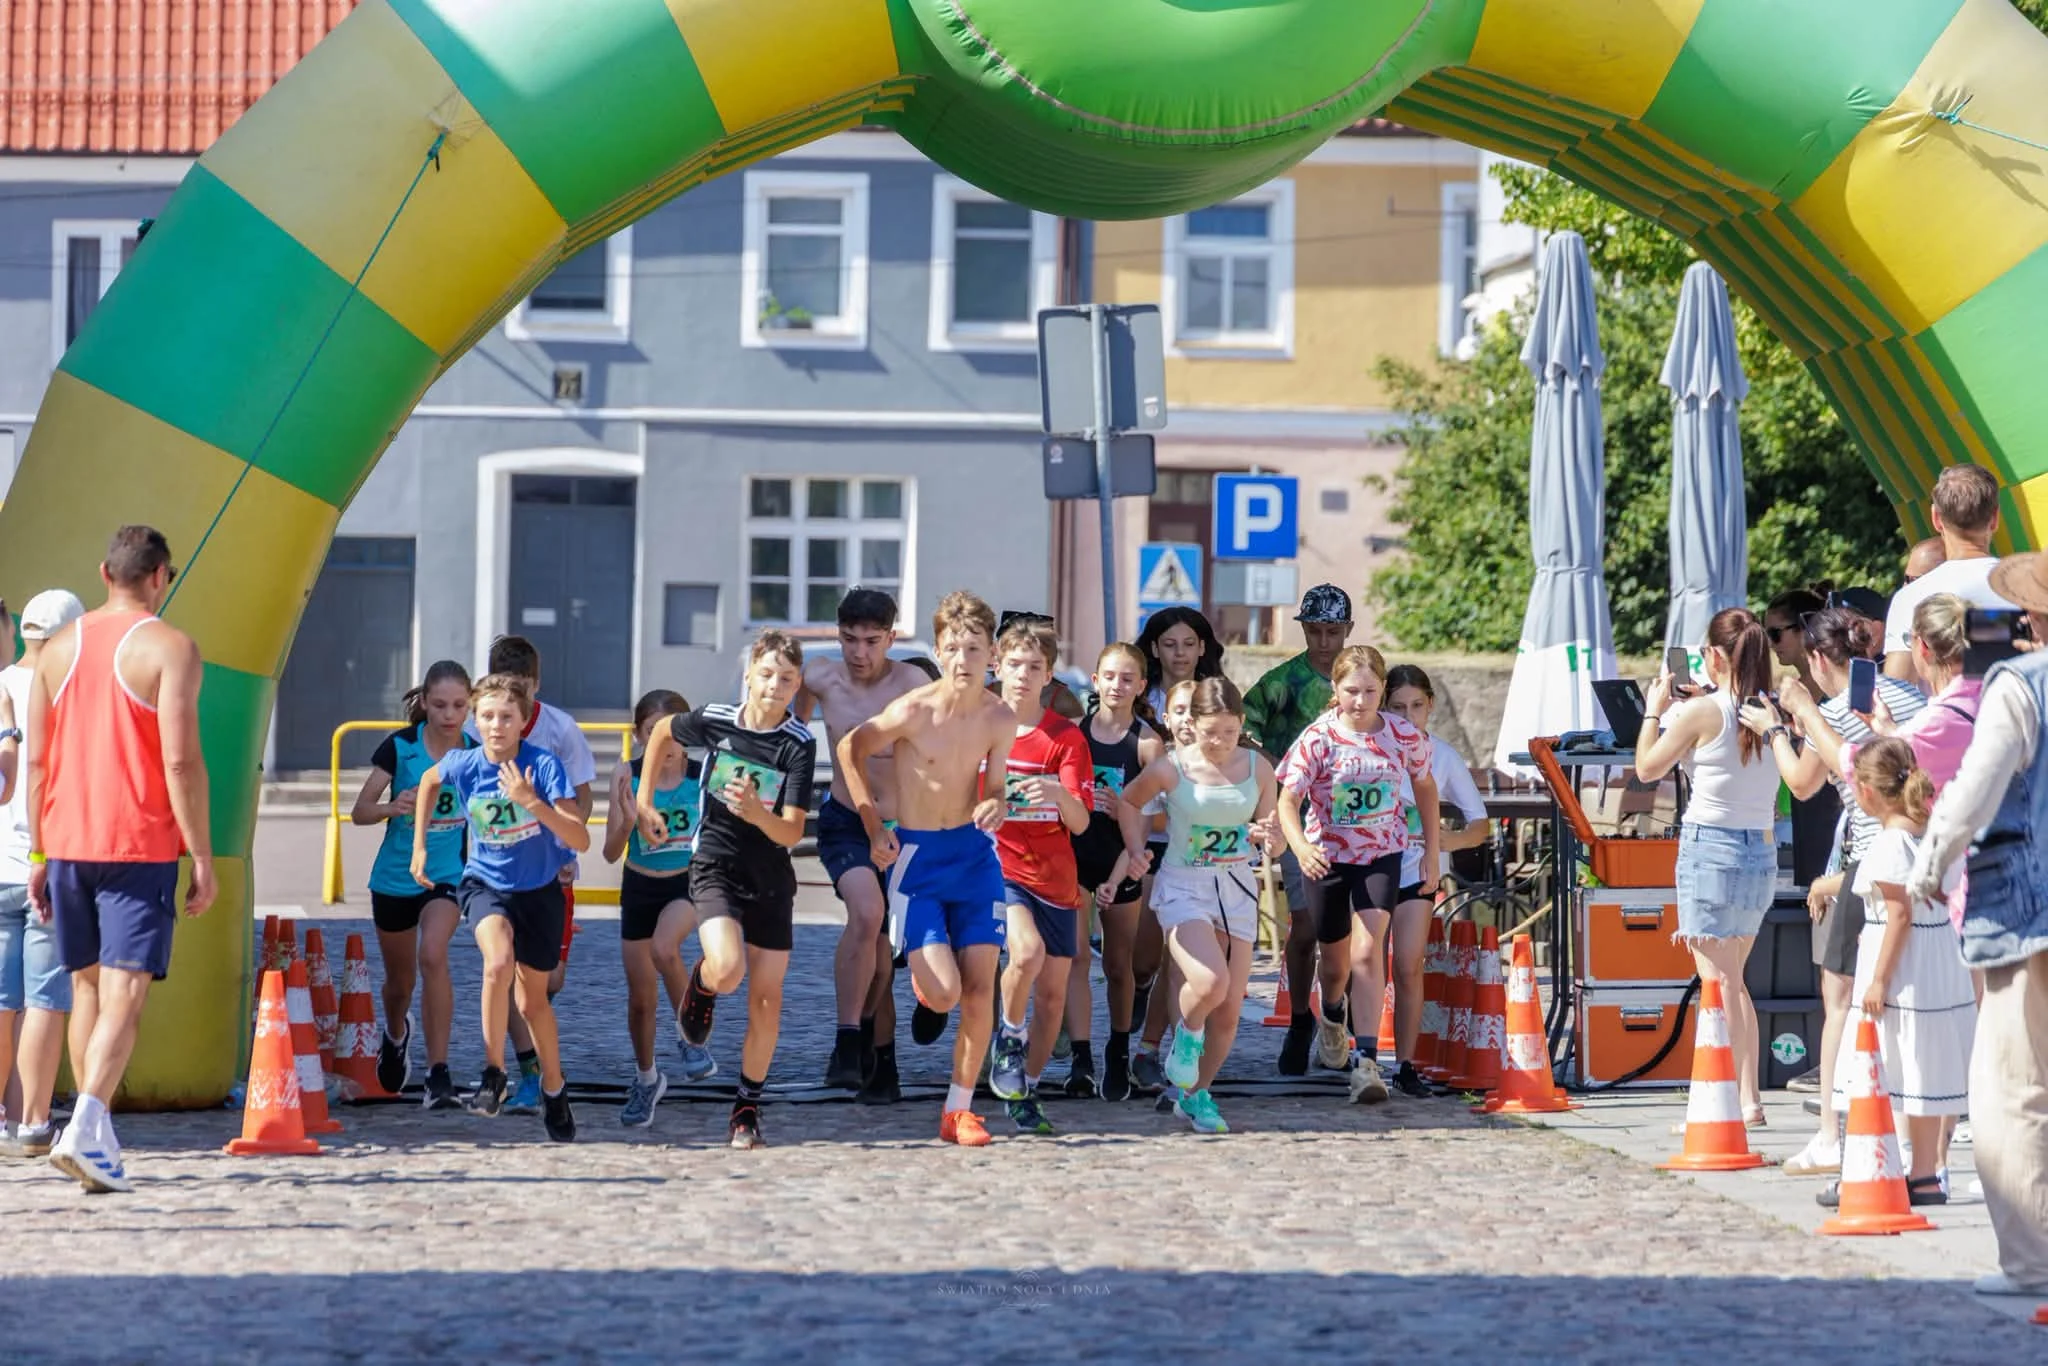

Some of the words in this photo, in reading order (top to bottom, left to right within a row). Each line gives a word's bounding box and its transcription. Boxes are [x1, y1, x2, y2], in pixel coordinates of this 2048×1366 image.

[1232, 483, 1283, 550] P
[1346, 787, 1381, 810] 30
[485, 801, 517, 825] 21
[1202, 830, 1239, 853] 22
